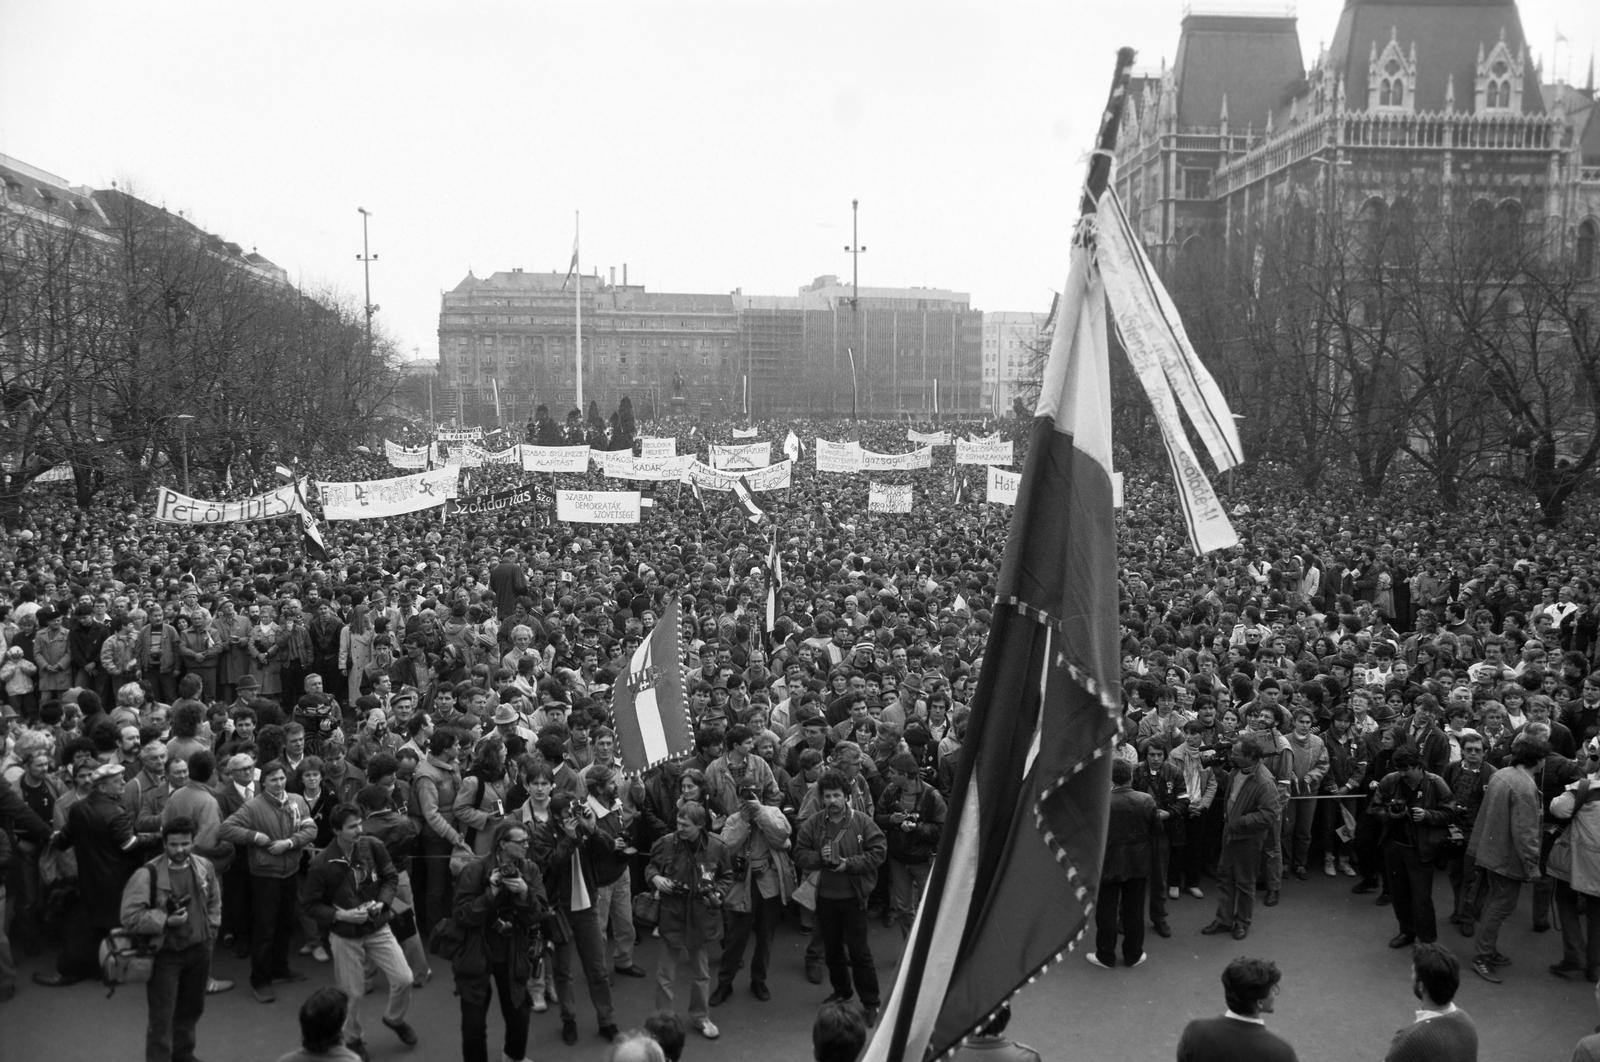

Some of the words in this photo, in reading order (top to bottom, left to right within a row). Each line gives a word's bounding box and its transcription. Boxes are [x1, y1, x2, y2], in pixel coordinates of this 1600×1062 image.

[451, 489, 532, 515] Szolidaritás
[565, 493, 594, 502] SZABAD
[575, 501, 622, 511] DEMOKRATÁK
